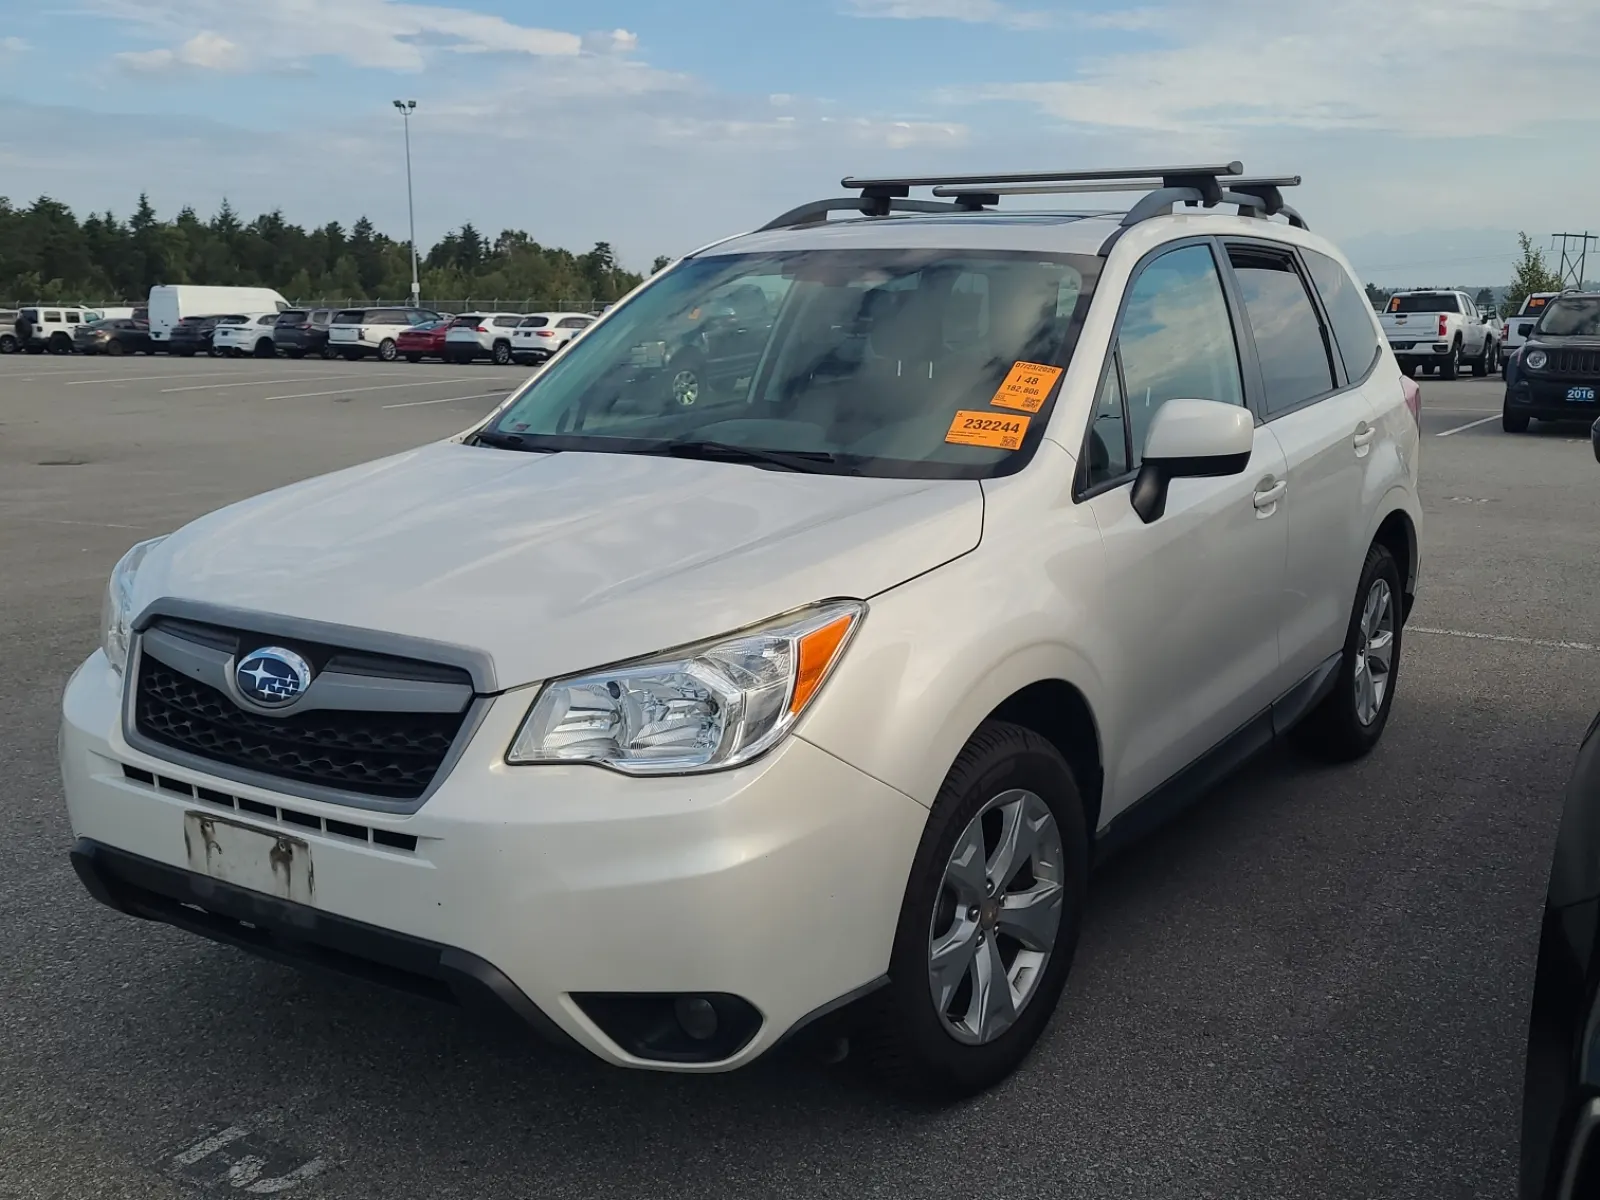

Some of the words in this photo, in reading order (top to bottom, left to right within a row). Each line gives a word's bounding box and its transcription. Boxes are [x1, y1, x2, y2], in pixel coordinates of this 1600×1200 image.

[1024, 376, 1039, 385] 48
[1567, 389, 1594, 399] 2016
[963, 418, 1020, 433] 232244
